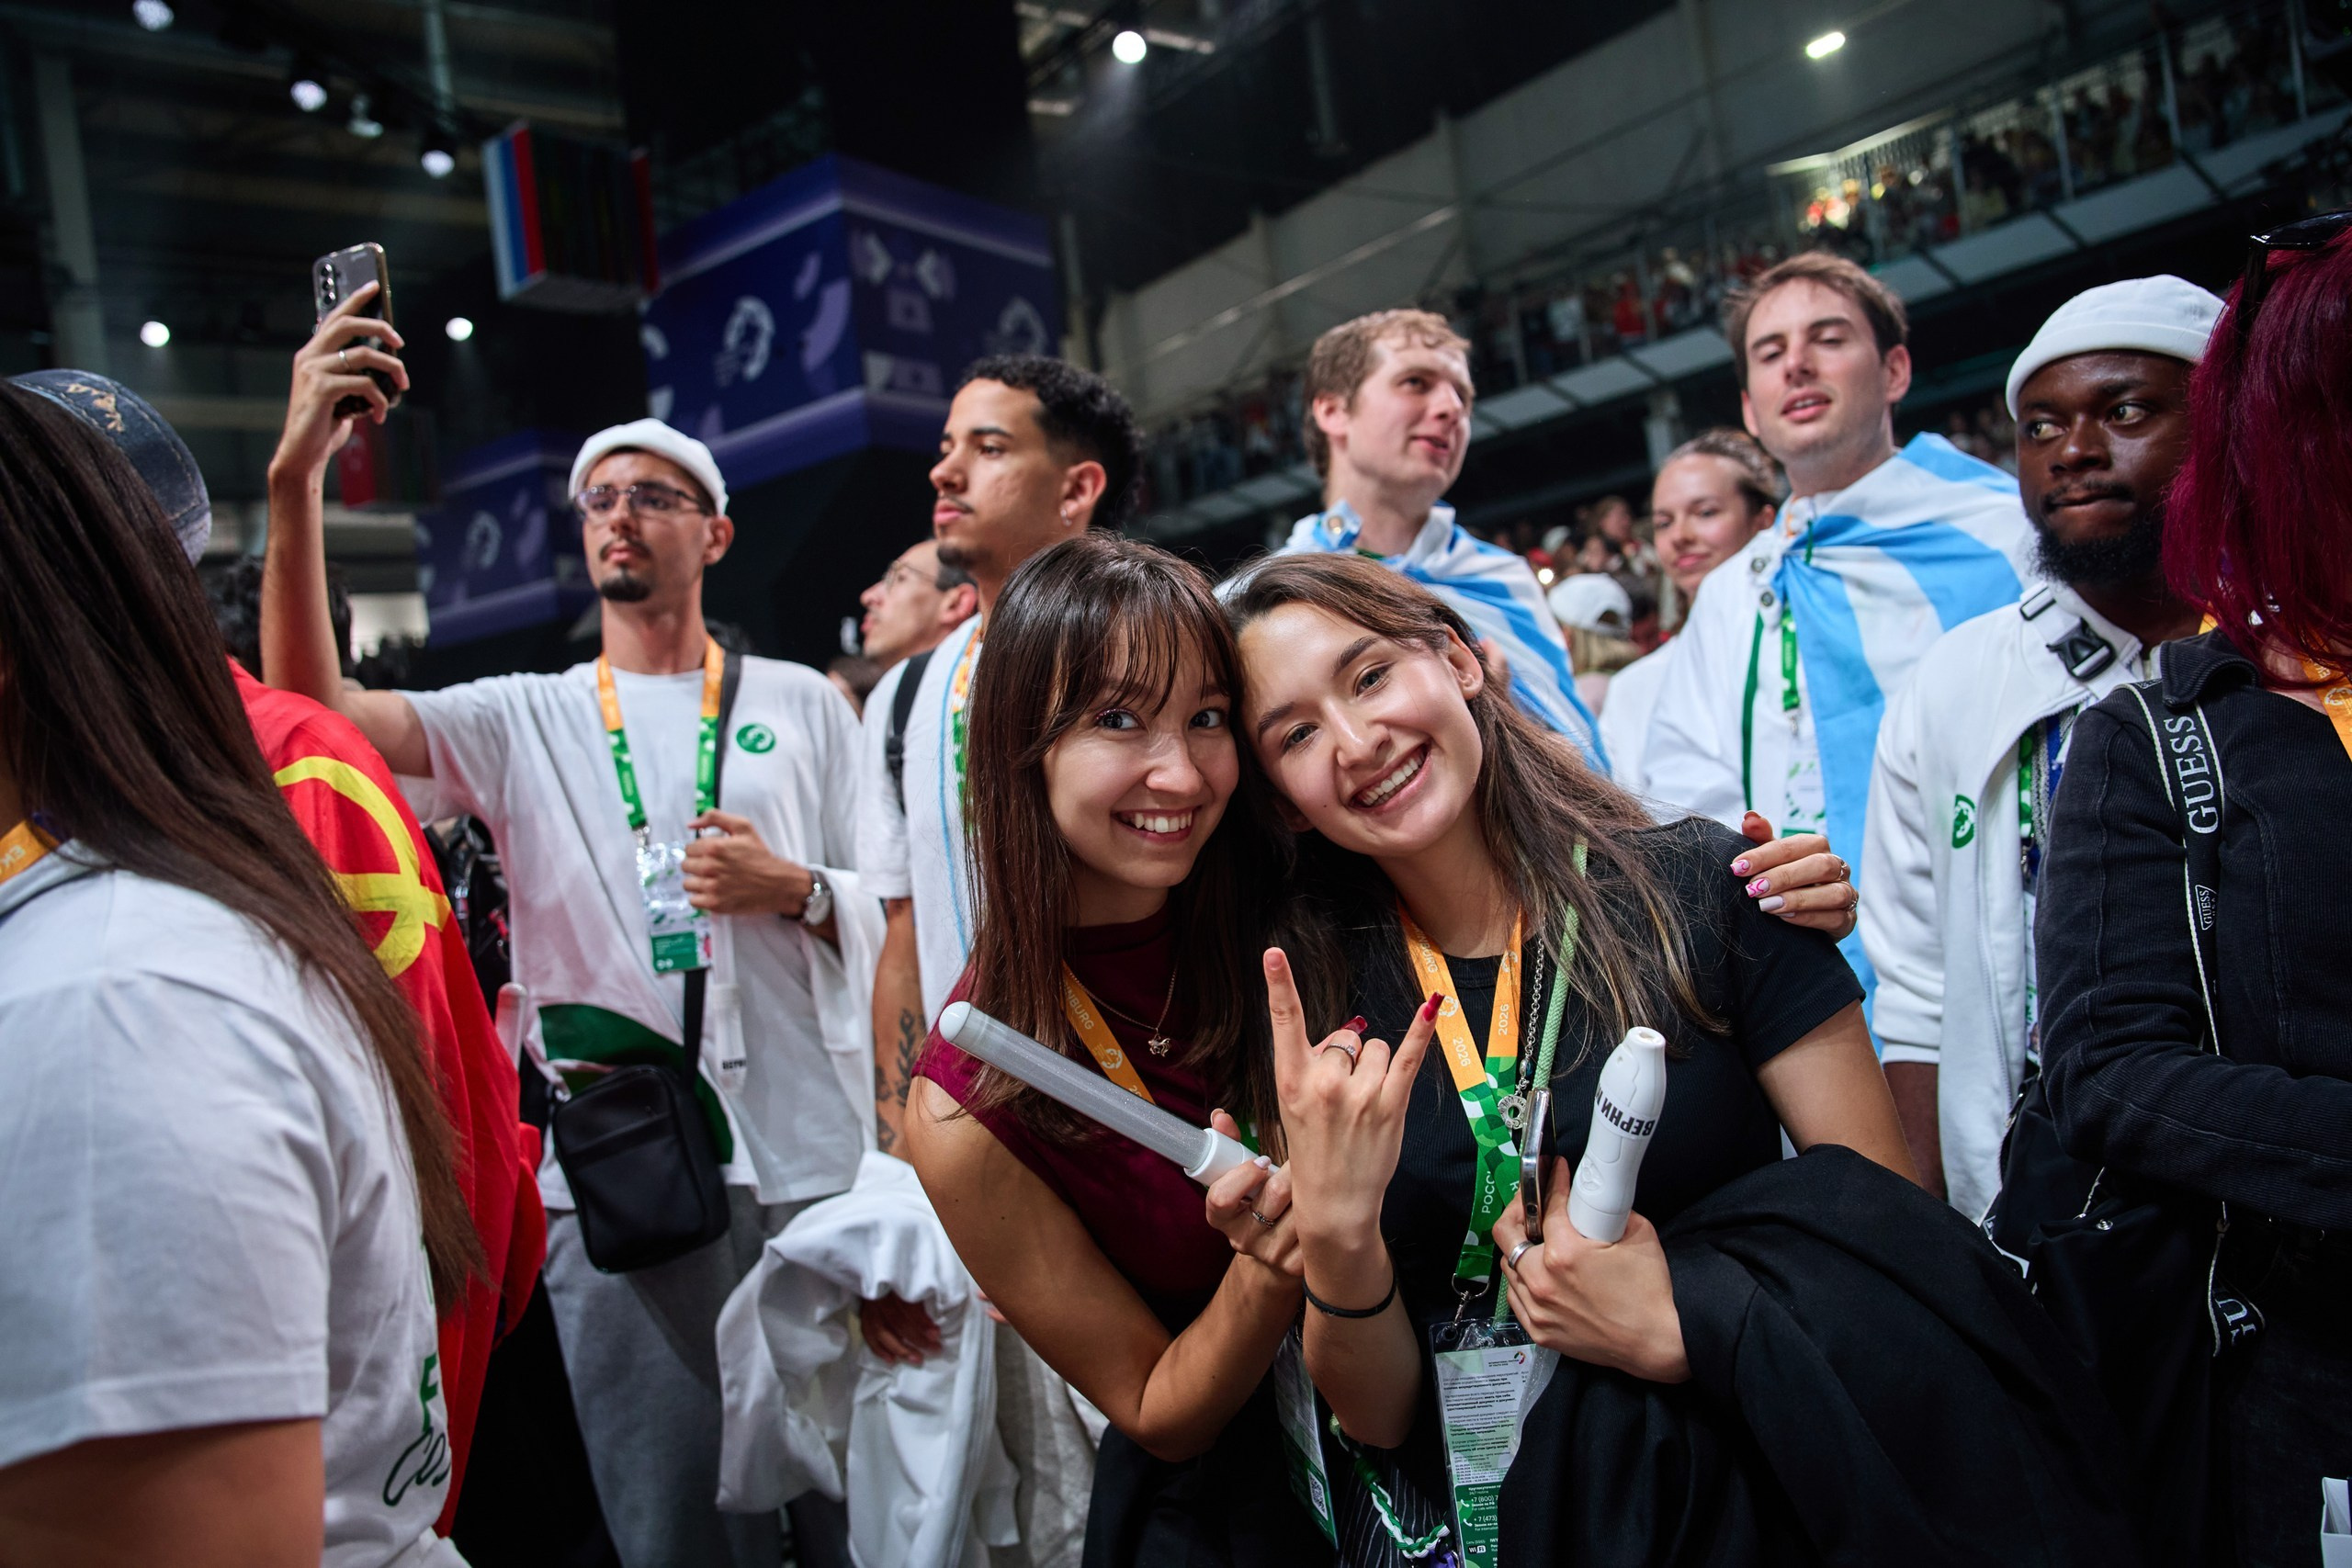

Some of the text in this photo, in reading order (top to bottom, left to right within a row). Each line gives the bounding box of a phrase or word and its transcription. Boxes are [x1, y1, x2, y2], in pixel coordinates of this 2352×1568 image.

[2163, 716, 2219, 836] GUESS
[2199, 889, 2212, 924] GUESS
[1498, 1003, 1510, 1036] 2026
[1453, 1036, 1471, 1067] 2026
[1600, 1098, 1656, 1136] ВЕРНИ
[1481, 1171, 1496, 1213] РОСС
